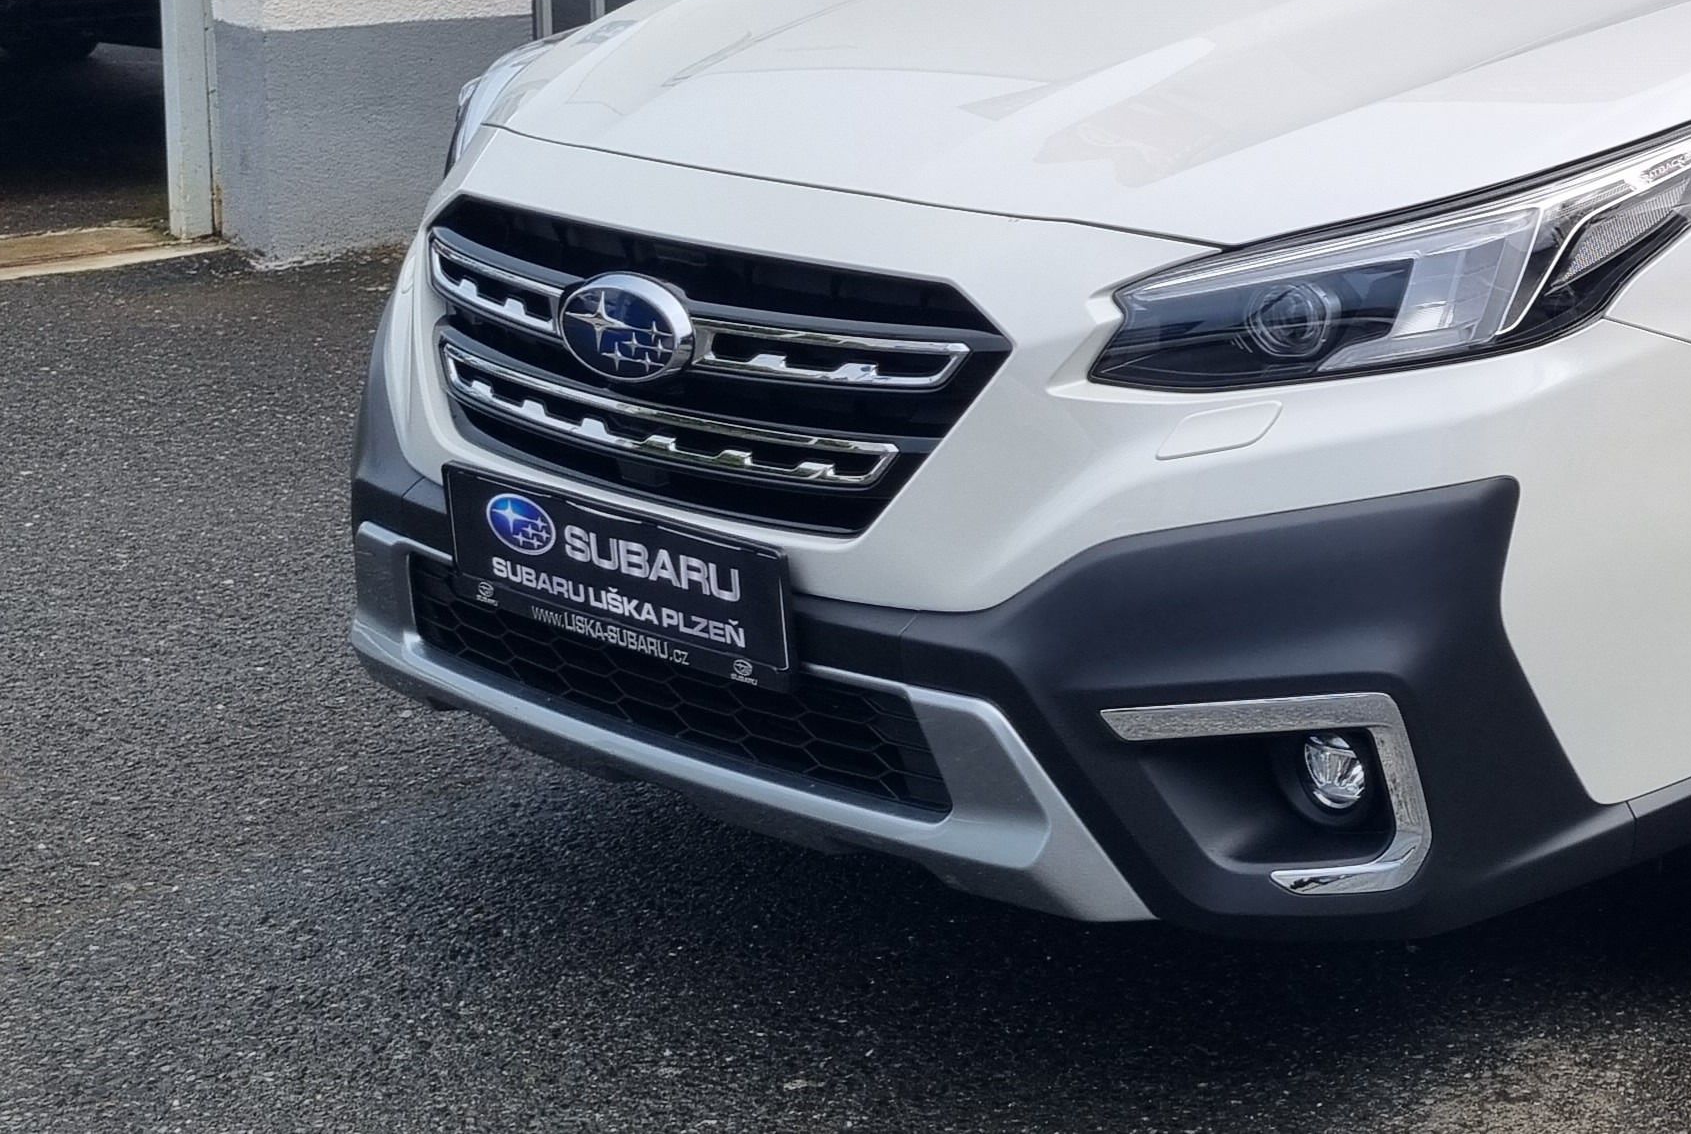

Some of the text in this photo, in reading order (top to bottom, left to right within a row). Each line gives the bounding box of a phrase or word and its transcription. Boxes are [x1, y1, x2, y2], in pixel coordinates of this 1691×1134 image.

[565, 524, 741, 602] SUBARU
[492, 556, 746, 649] SUBARU LIŠKA PLZEŇ
[531, 605, 690, 666] www.LISKA-SUBARU.cz
